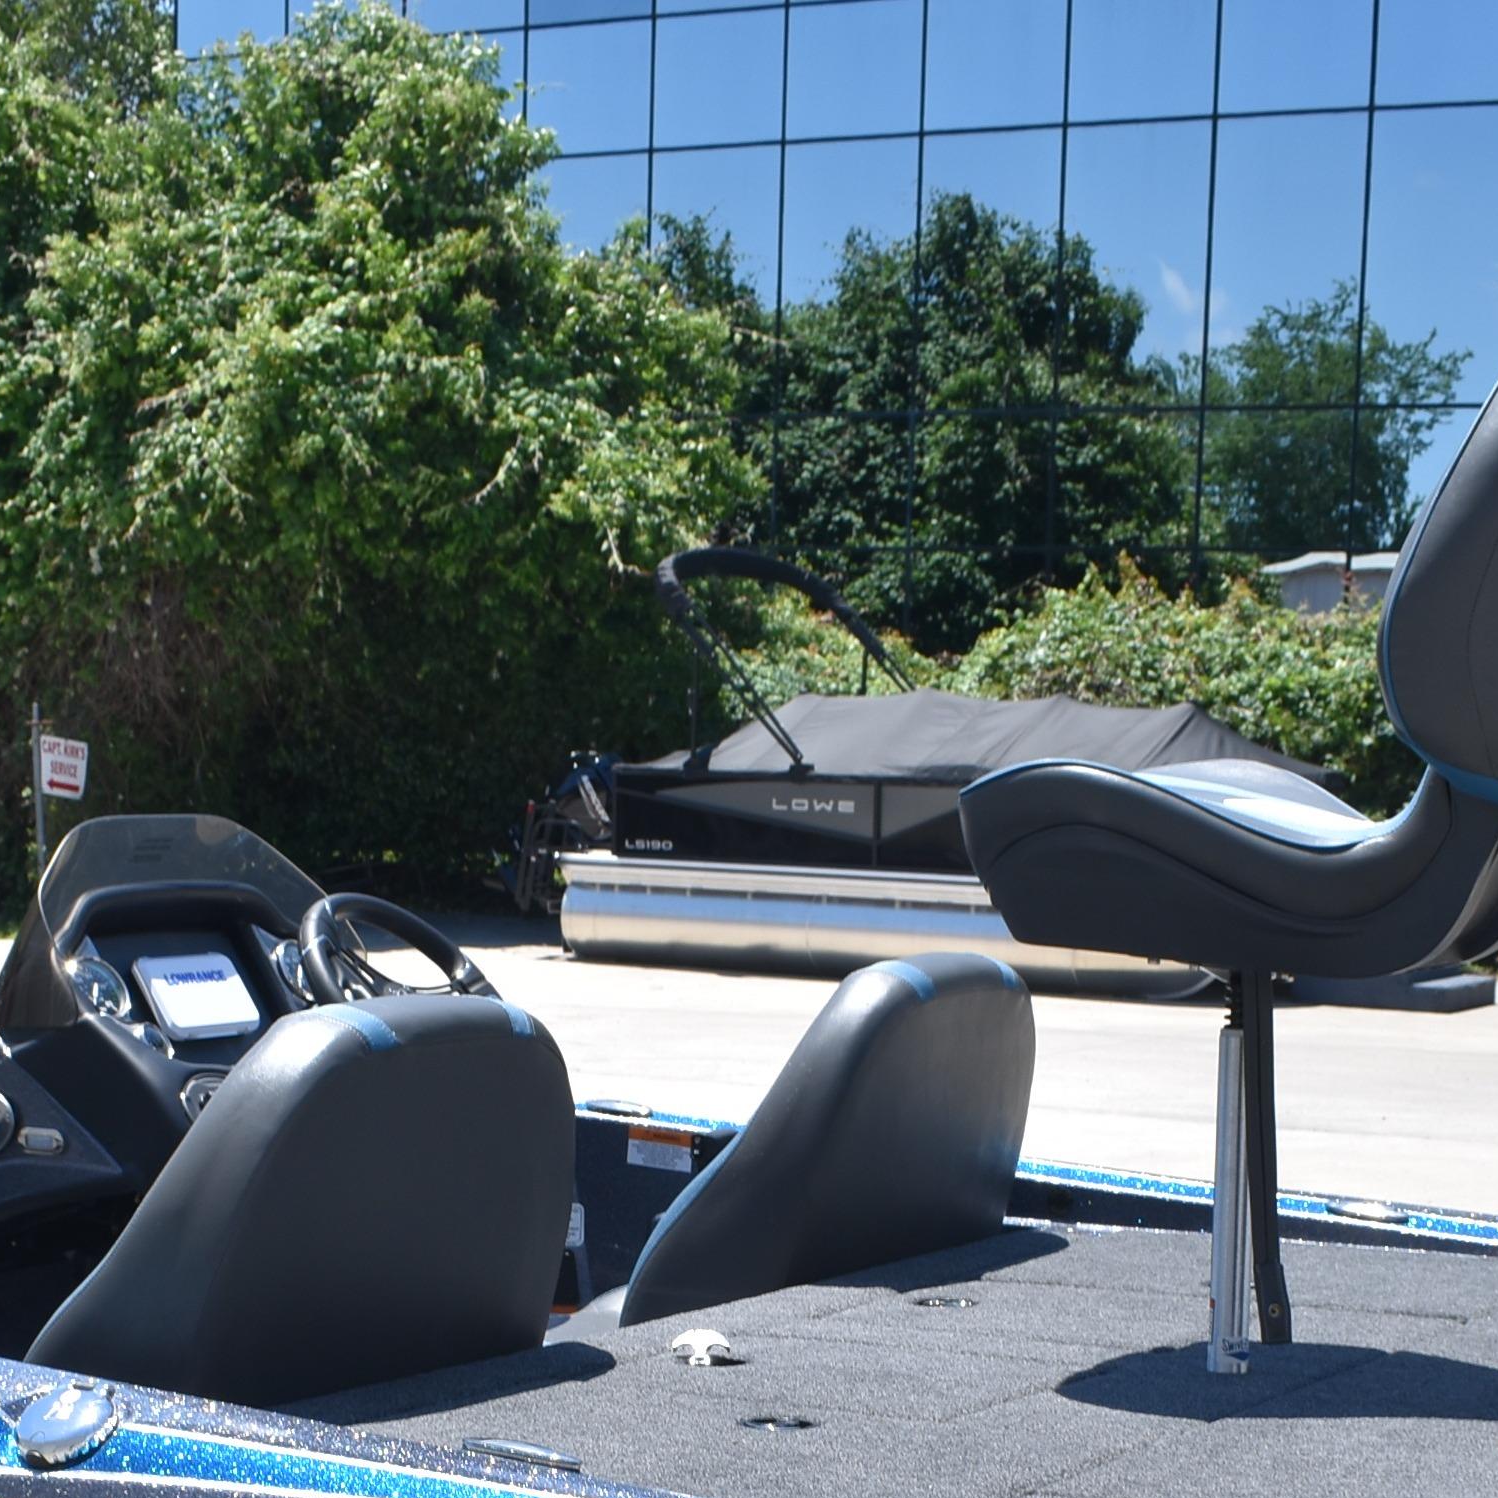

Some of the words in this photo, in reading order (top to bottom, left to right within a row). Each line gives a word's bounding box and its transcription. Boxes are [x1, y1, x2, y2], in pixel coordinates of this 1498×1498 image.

[771, 797, 856, 814] LOWE
[624, 838, 674, 852] LS190
[163, 969, 228, 986] LOWRANCE
